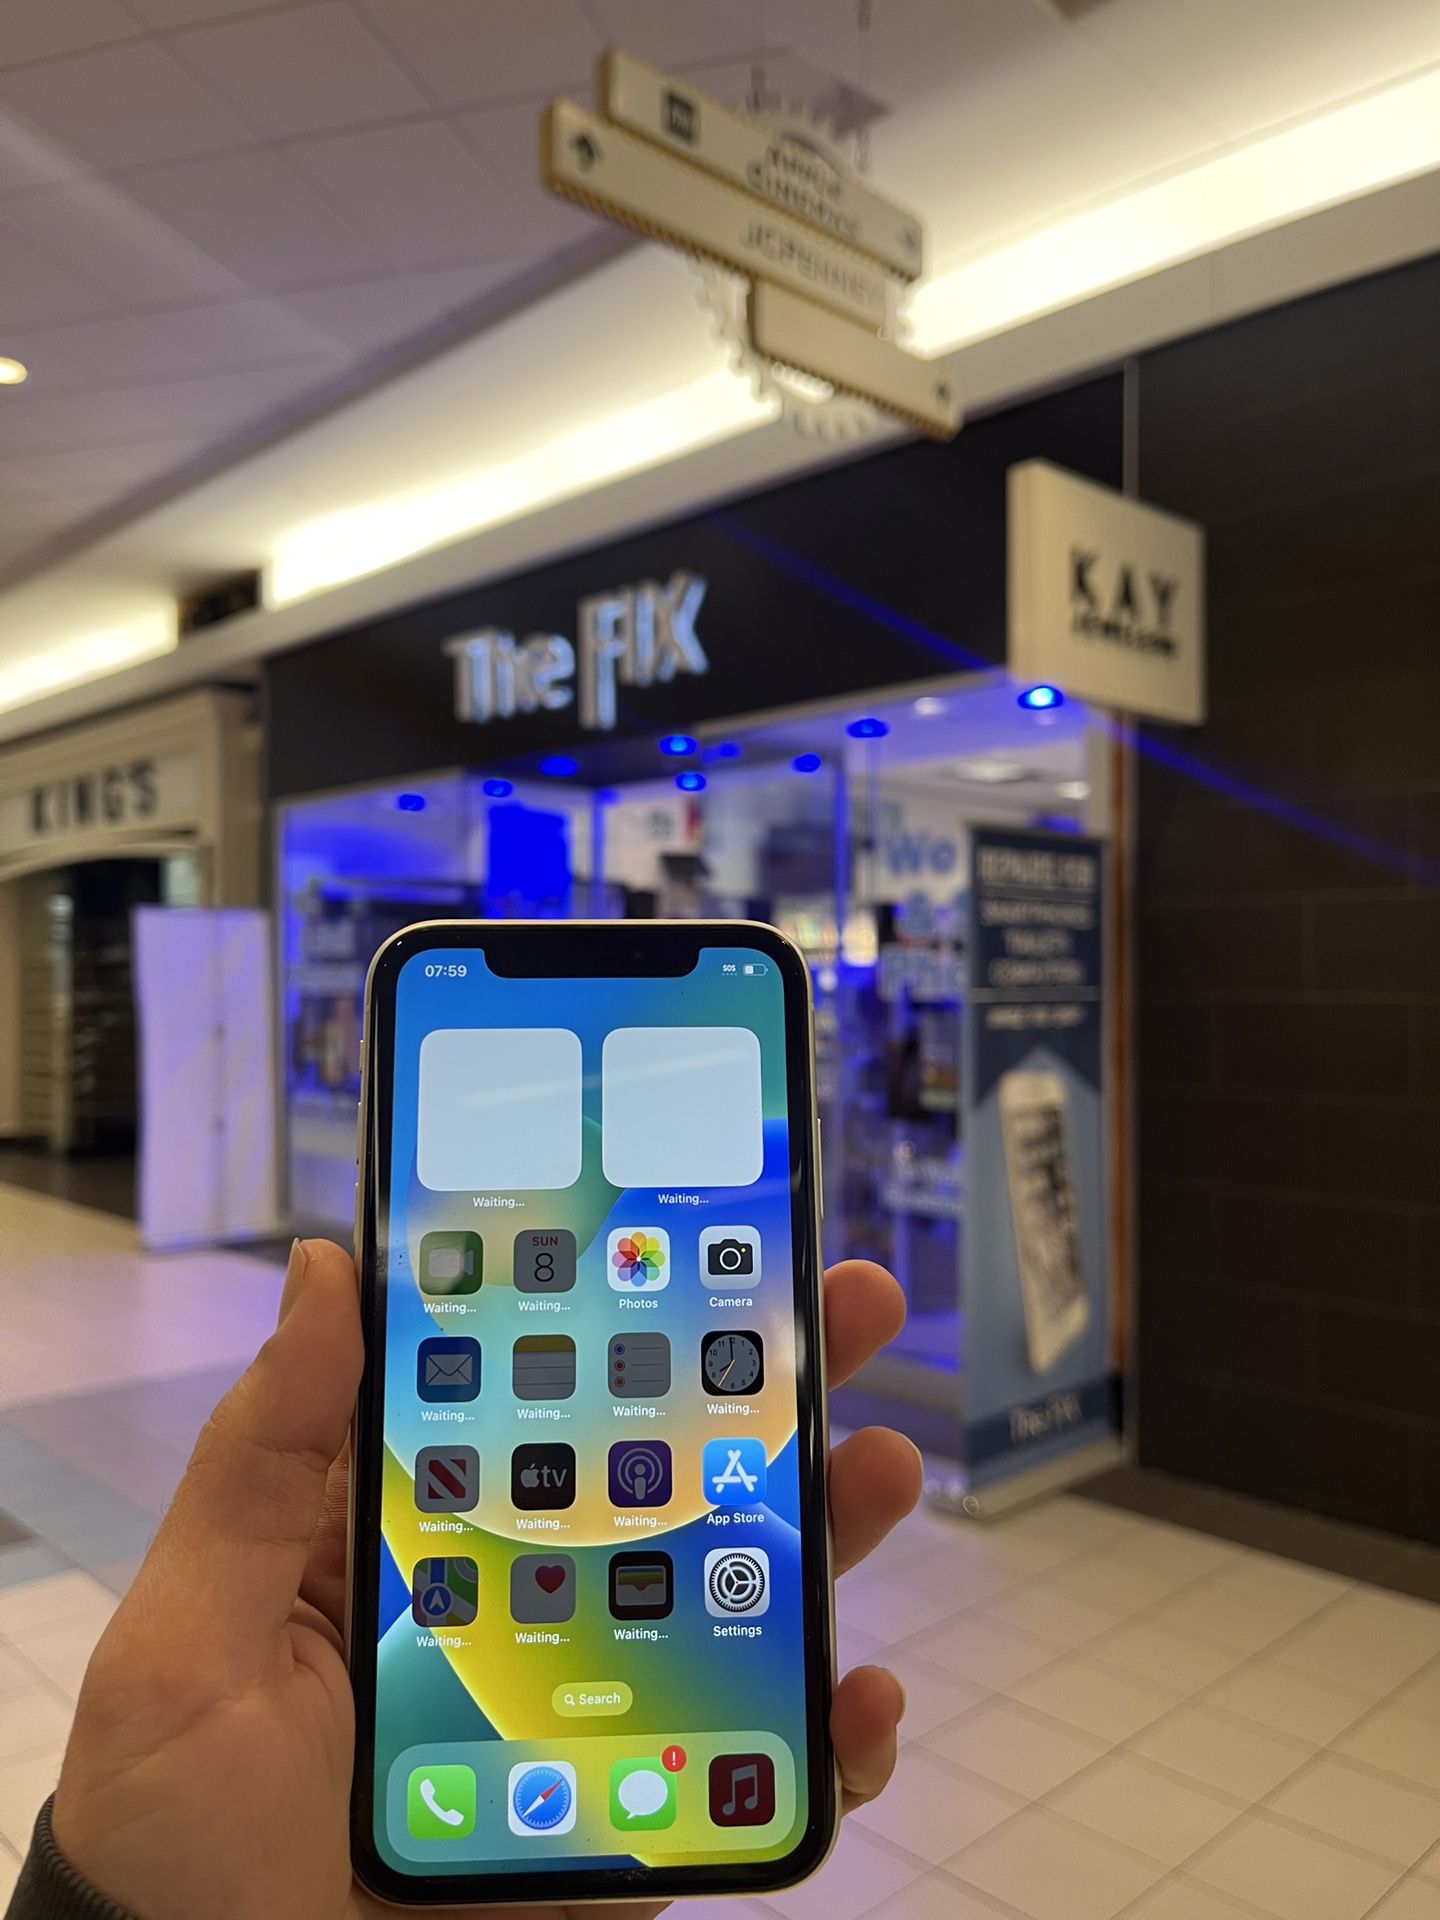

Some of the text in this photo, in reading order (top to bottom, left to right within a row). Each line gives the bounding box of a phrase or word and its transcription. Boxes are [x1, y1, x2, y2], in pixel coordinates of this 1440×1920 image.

[1070, 546, 1181, 626] KAY
[425, 965, 467, 977] 07:59
[722, 964, 737, 972] SOS
[473, 1196, 525, 1209] Waiting...
[658, 1193, 709, 1206] Waiting...
[532, 1236, 558, 1246] SUN
[534, 1253, 555, 1282] 8
[424, 1302, 477, 1314] Waiting...
[518, 1300, 570, 1312] Waiting...
[619, 1298, 658, 1309] Photos
[709, 1296, 753, 1308] Camera
[517, 1408, 570, 1420] Waiting...
[613, 1405, 666, 1418] Waiting...
[707, 1403, 759, 1415] Waiting...
[421, 1410, 475, 1422] Waiting...
[542, 1467, 567, 1488] tv
[516, 1518, 570, 1530] Waiting...
[614, 1515, 667, 1528] Waiting...
[707, 1512, 764, 1525] App Store
[419, 1520, 473, 1533] Waiting...
[515, 1631, 570, 1645] Waiting...
[614, 1627, 668, 1641] Waiting...
[713, 1625, 762, 1638] Settings
[416, 1634, 471, 1648] Waiting...
[579, 1693, 620, 1705] Search
